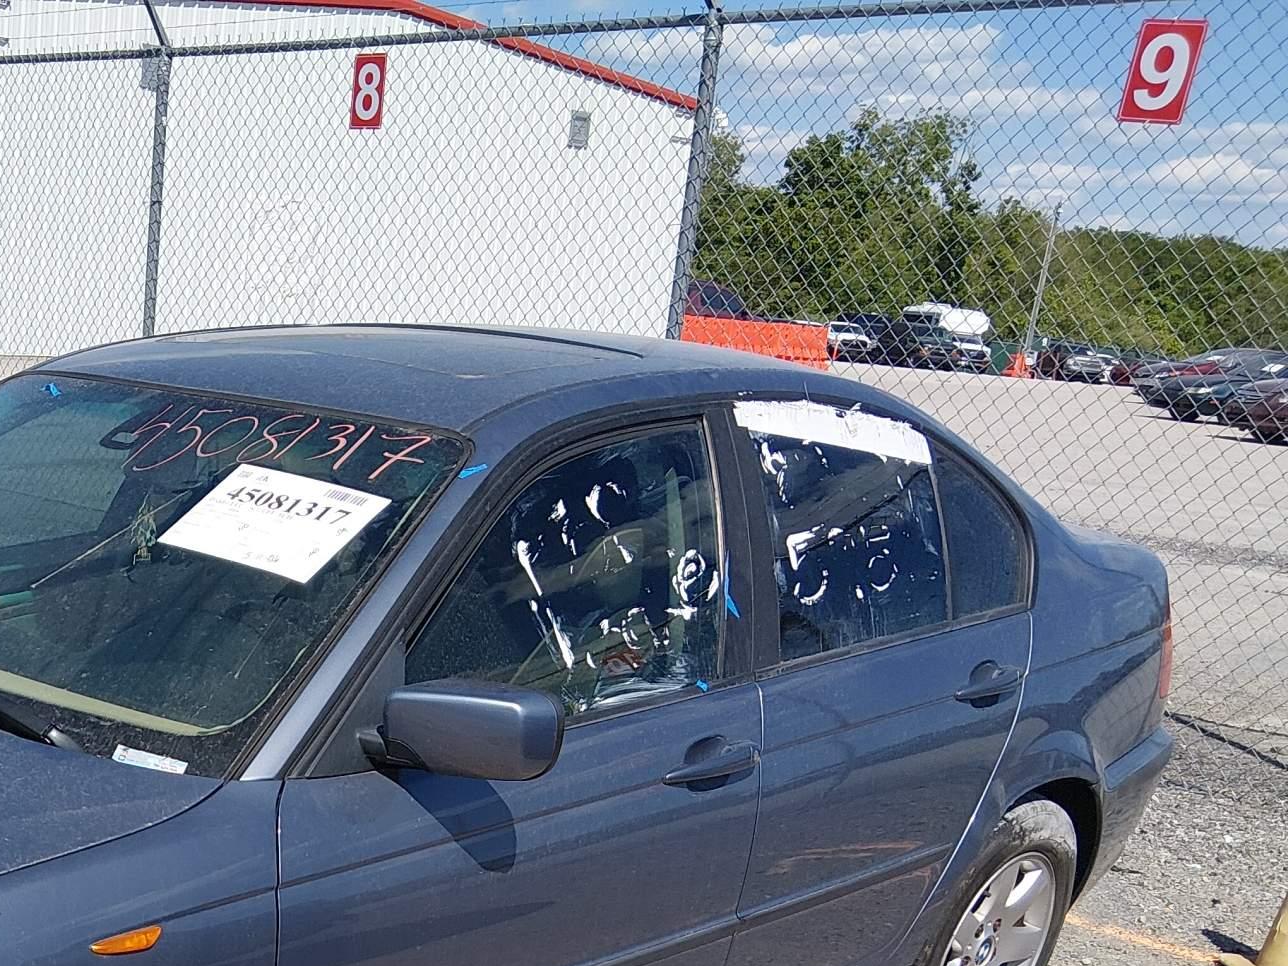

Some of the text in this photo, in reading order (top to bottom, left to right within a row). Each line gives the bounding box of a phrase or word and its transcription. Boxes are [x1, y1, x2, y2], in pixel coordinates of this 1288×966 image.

[355, 63, 381, 120] 8
[1133, 33, 1190, 110] 9
[121, 403, 432, 481] 45081317
[226, 485, 352, 526] 45081317
